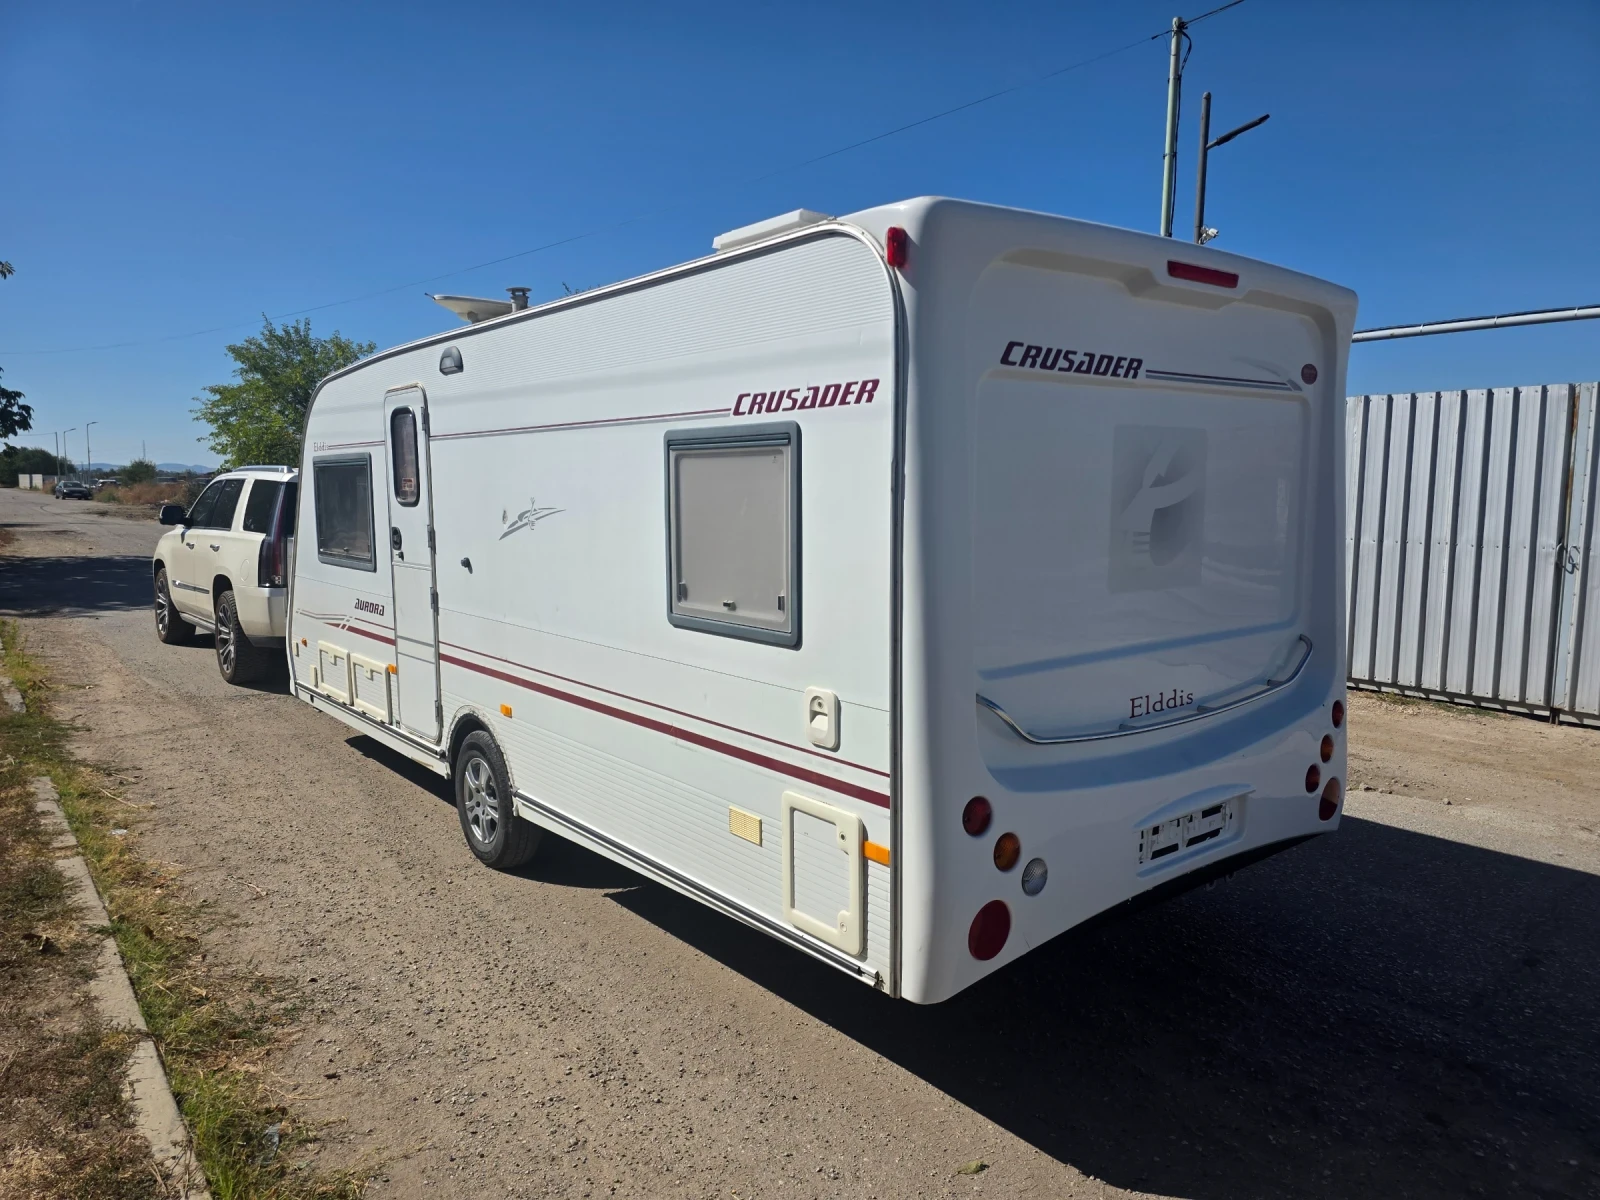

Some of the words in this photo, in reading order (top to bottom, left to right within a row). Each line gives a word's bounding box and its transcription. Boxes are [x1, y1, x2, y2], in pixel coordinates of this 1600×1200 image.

[1000, 341, 1143, 379] CRUSADER
[732, 378, 880, 416] CRUSADER
[354, 598, 385, 616] AURORA
[1129, 689, 1194, 719] Elddis
